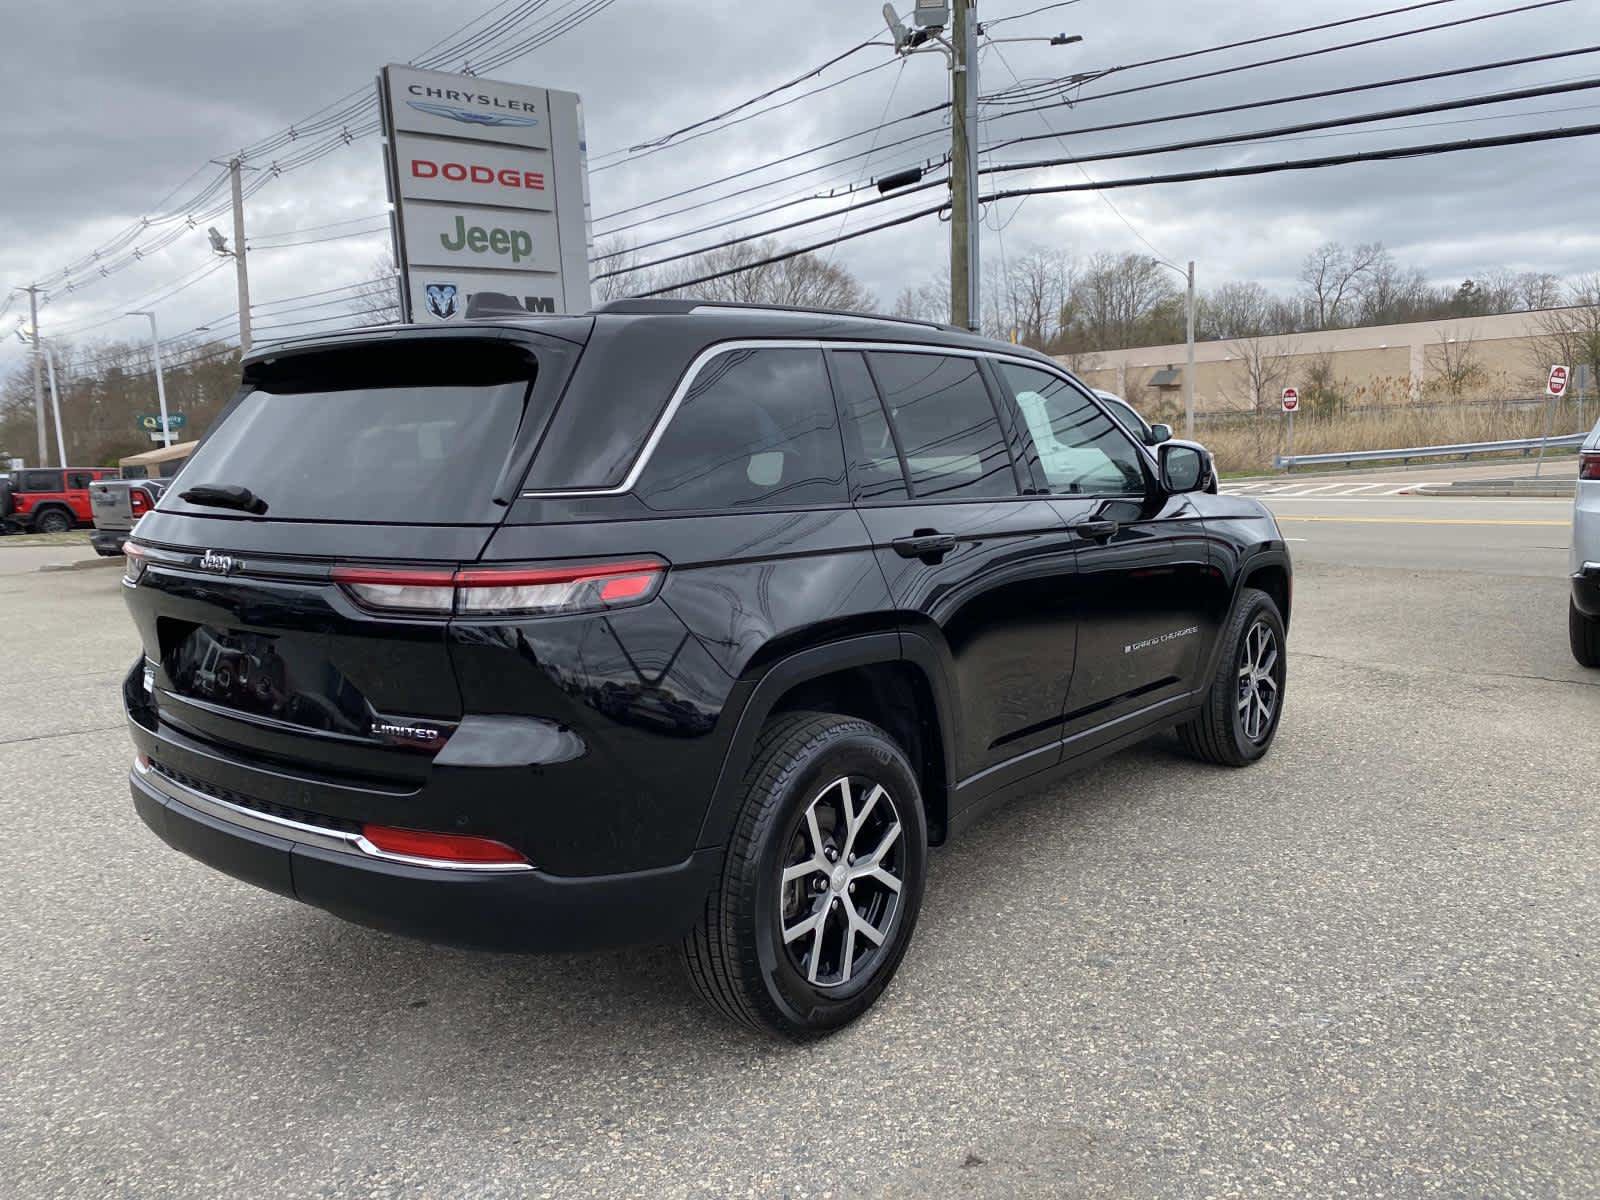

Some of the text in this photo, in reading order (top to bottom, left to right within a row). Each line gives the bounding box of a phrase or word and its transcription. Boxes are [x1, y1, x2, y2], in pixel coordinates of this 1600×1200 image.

[408, 84, 536, 113] CHRYSLER
[411, 159, 545, 190] DODGE
[439, 215, 533, 263] Jeep
[200, 549, 232, 573] Jeep
[371, 723, 438, 740] LIMITED
